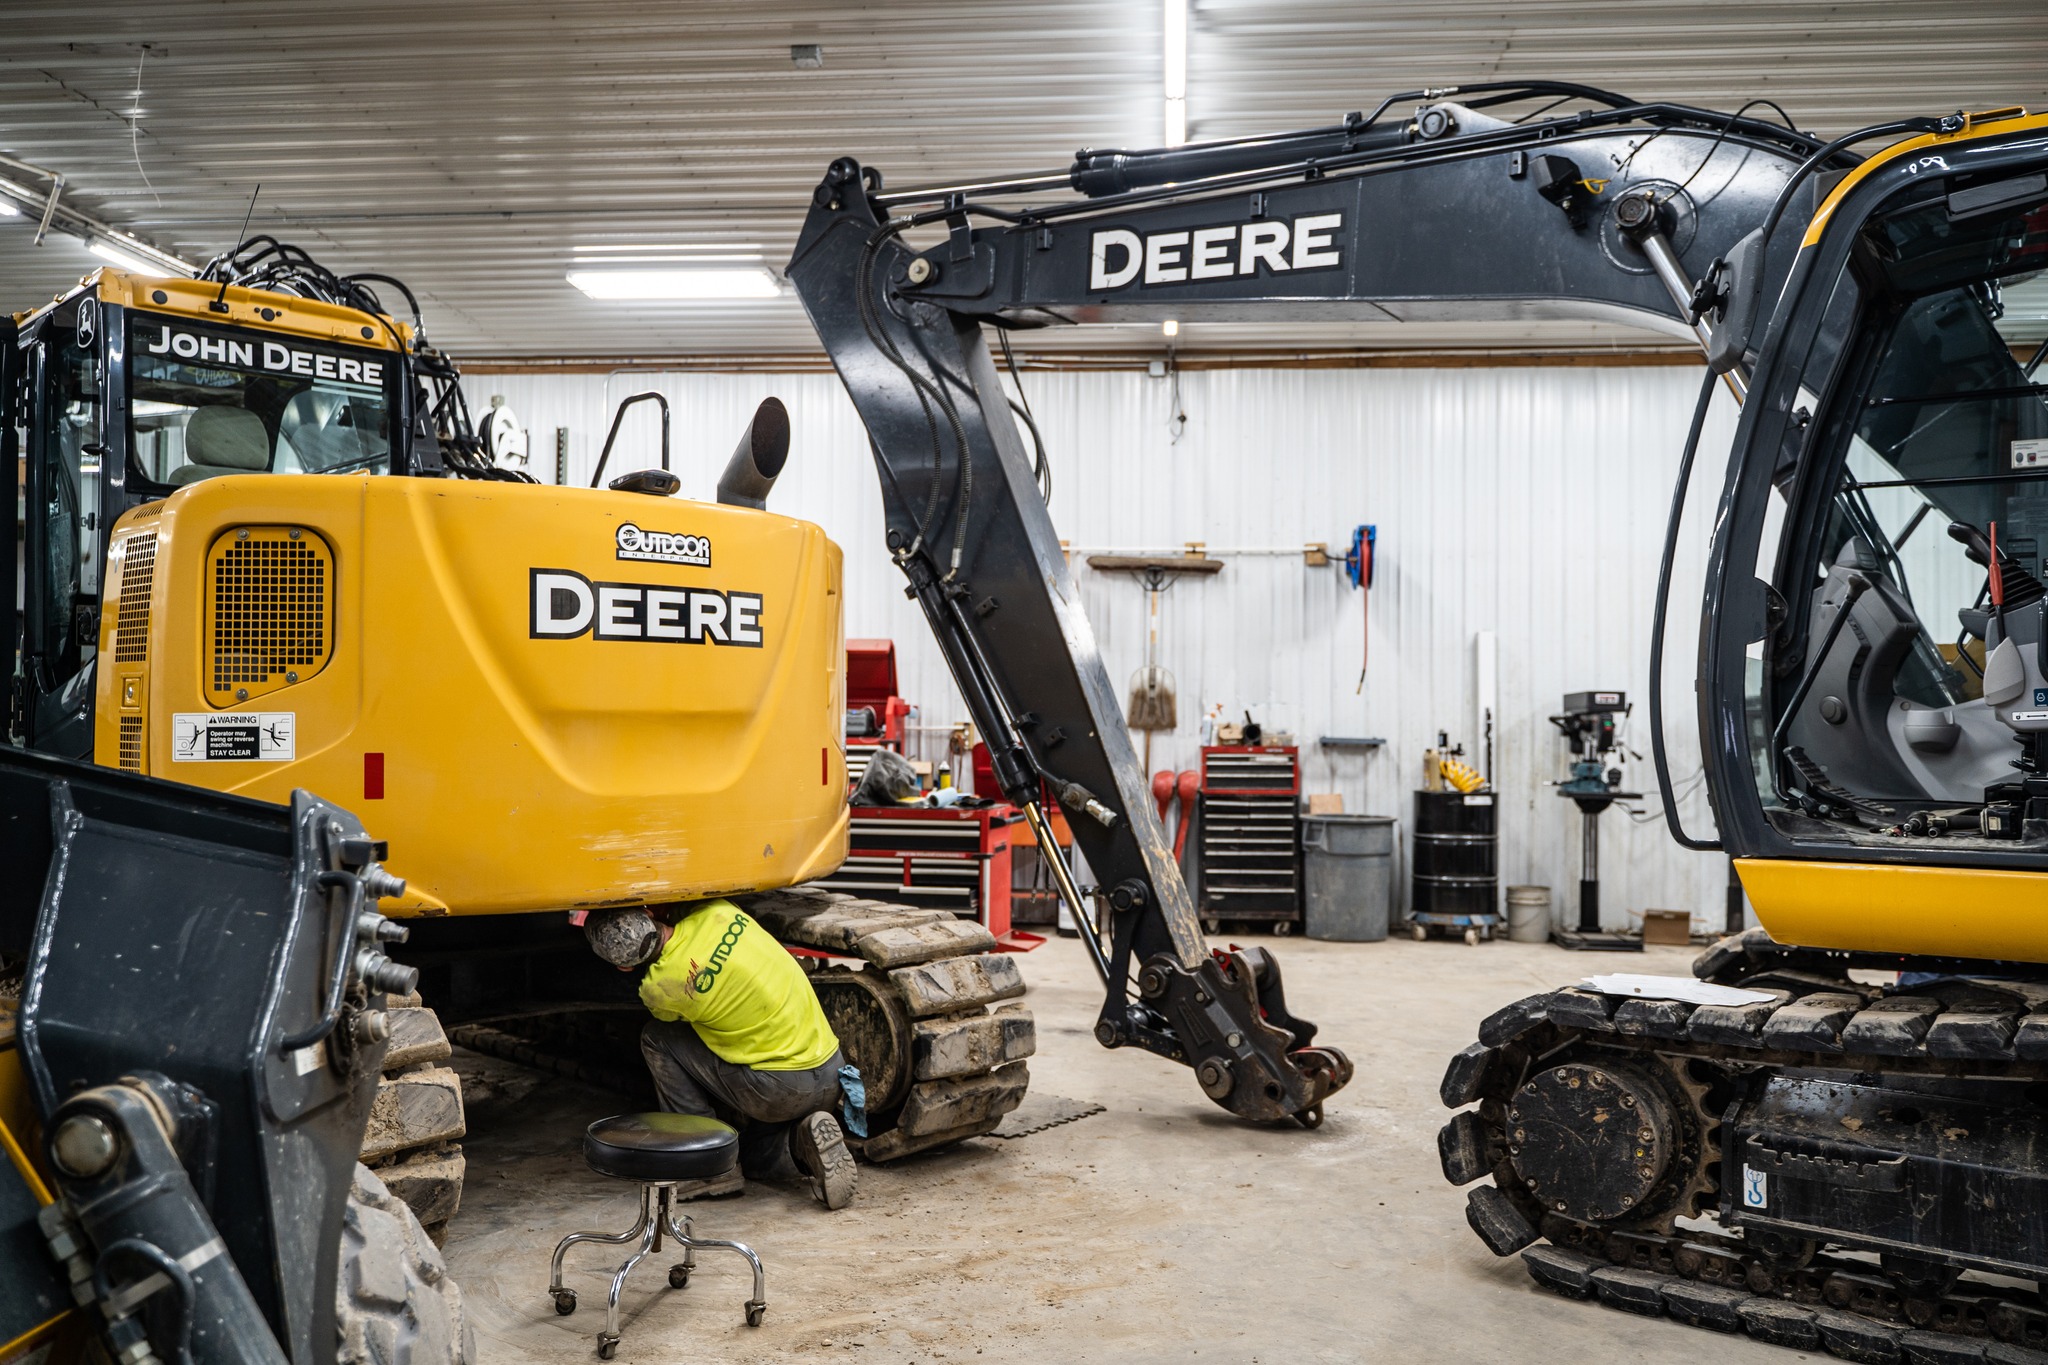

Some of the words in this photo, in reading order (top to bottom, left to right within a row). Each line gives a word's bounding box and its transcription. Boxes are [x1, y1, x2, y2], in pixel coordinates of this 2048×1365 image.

[1090, 213, 1342, 290] DEERE
[148, 325, 253, 367] JOHN
[263, 341, 383, 386] DEERE
[618, 524, 710, 558] OUTDOOR
[535, 573, 761, 643] DEERE
[217, 716, 257, 724] WARNING
[693, 913, 750, 994] OUTDOOR
